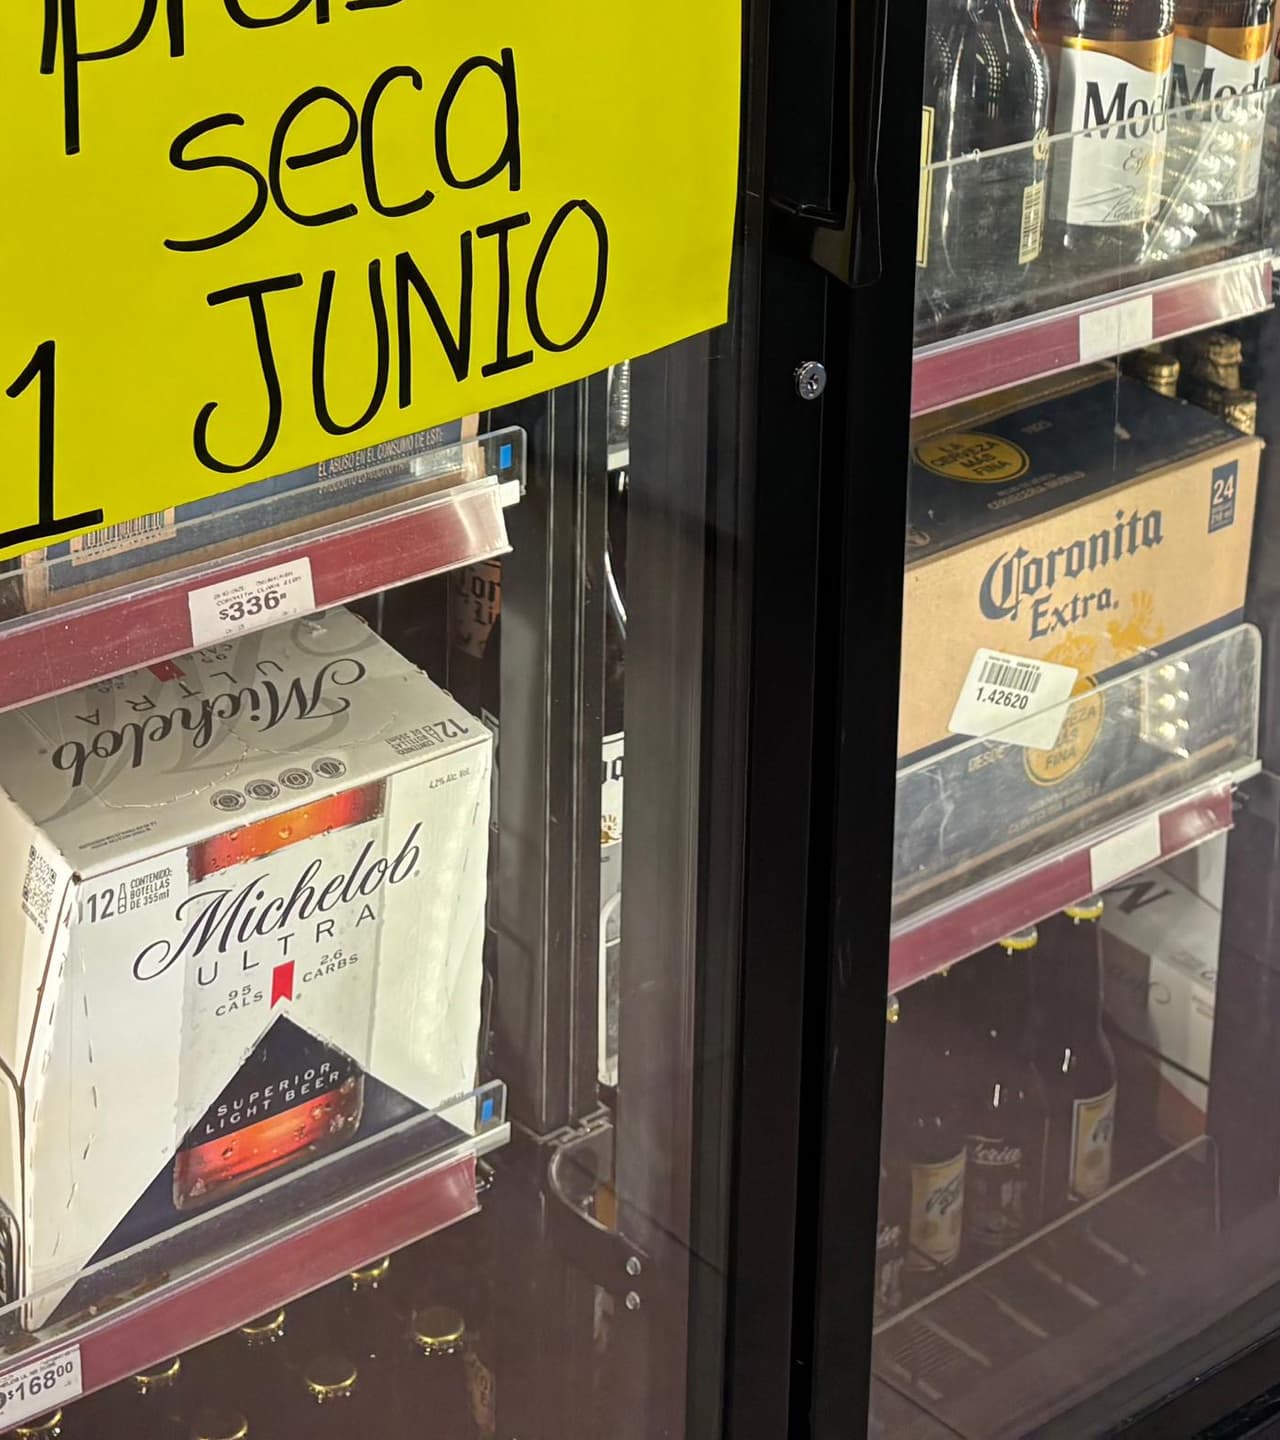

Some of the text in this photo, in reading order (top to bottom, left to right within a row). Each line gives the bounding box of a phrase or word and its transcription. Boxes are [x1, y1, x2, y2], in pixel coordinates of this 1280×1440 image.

[163, 46, 522, 254] seca
[190, 196, 609, 477] JUNIO
[1212, 477, 1234, 507] 24
[978, 508, 1165, 623] Coronita
[975, 685, 1029, 711] 1.42620
[52, 658, 367, 788] Michelob
[86, 888, 116, 924] 12
[129, 878, 171, 902] BOTELLAS
[133, 822, 423, 981] Michelob
[198, 906, 378, 986] ULTRA
[319, 949, 344, 966] 2.6
[302, 954, 359, 984] CARBS
[214, 991, 264, 1017] CALS
[228, 984, 253, 1001] 95
[205, 1070, 340, 1134] LIGHT BEER
[216, 1062, 332, 1117] SUPERIOR
